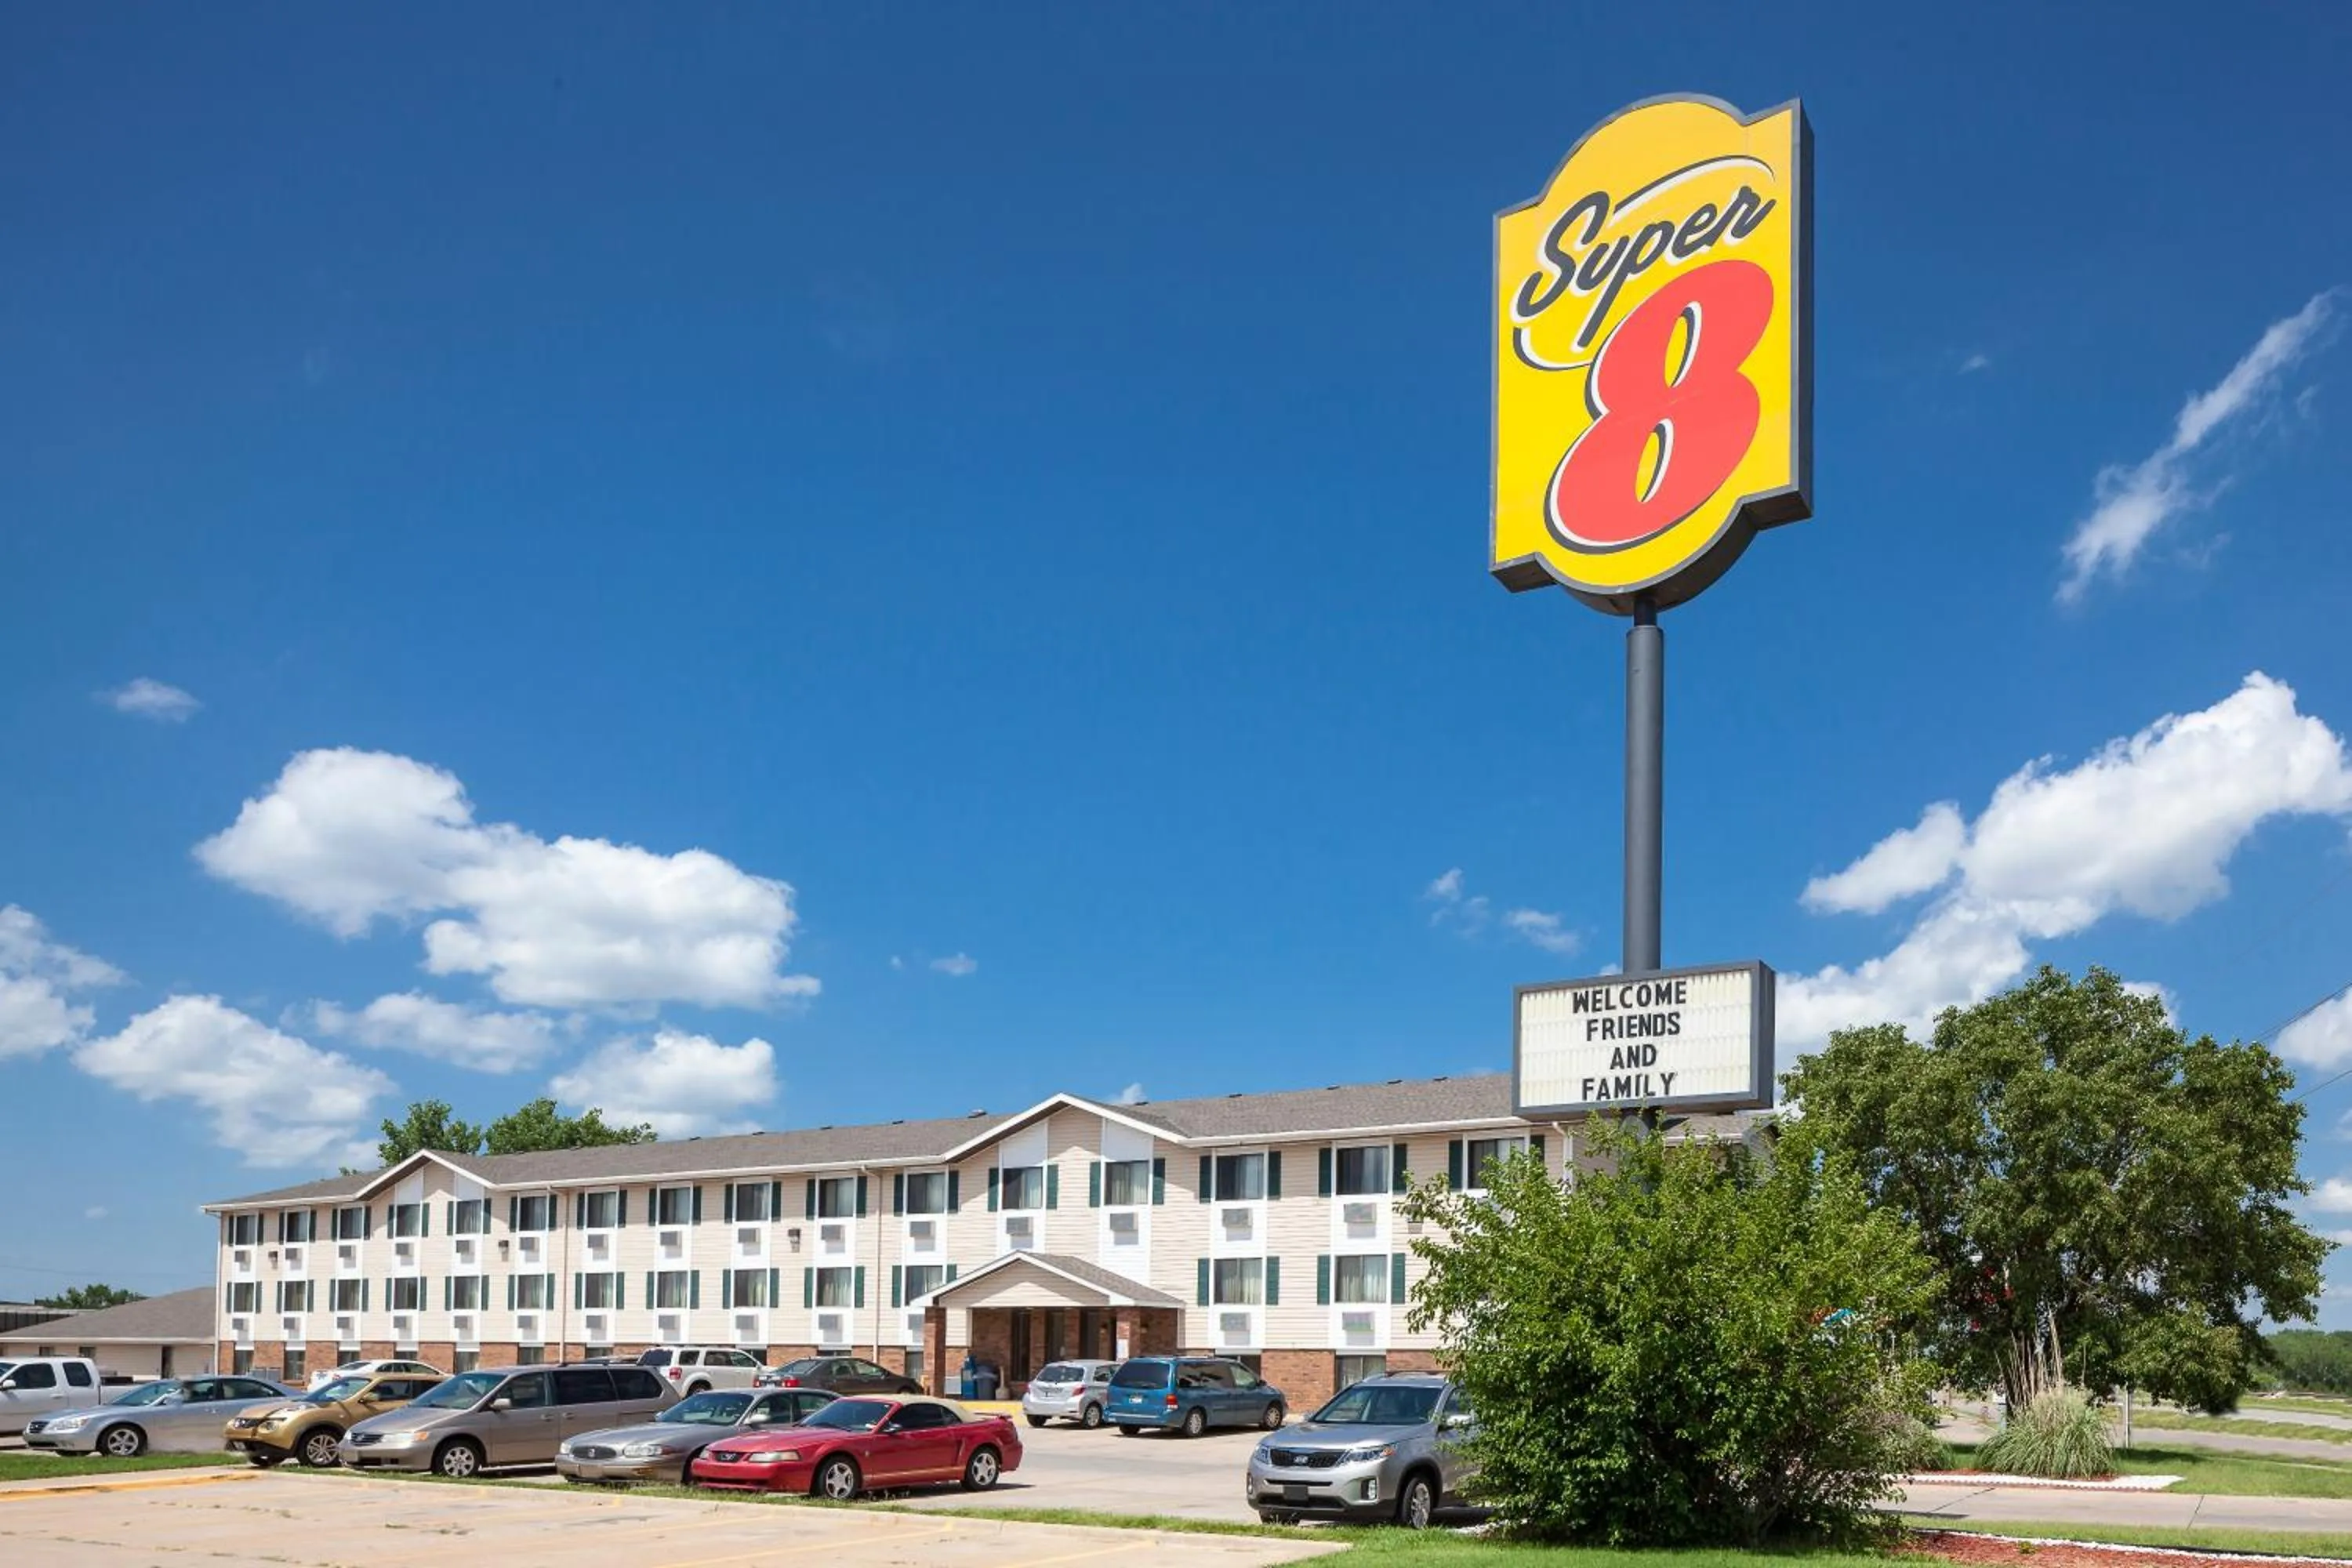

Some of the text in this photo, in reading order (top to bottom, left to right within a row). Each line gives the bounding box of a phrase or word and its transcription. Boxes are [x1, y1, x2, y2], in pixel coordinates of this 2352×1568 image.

[1514, 185, 1777, 348] Super
[1544, 260, 1774, 555] 8
[1573, 981, 1686, 1014] WELCOME
[1586, 1011, 1681, 1042] FRIENDS
[1610, 1044, 1657, 1069] AND
[1581, 1072, 1676, 1101] FAMILY
